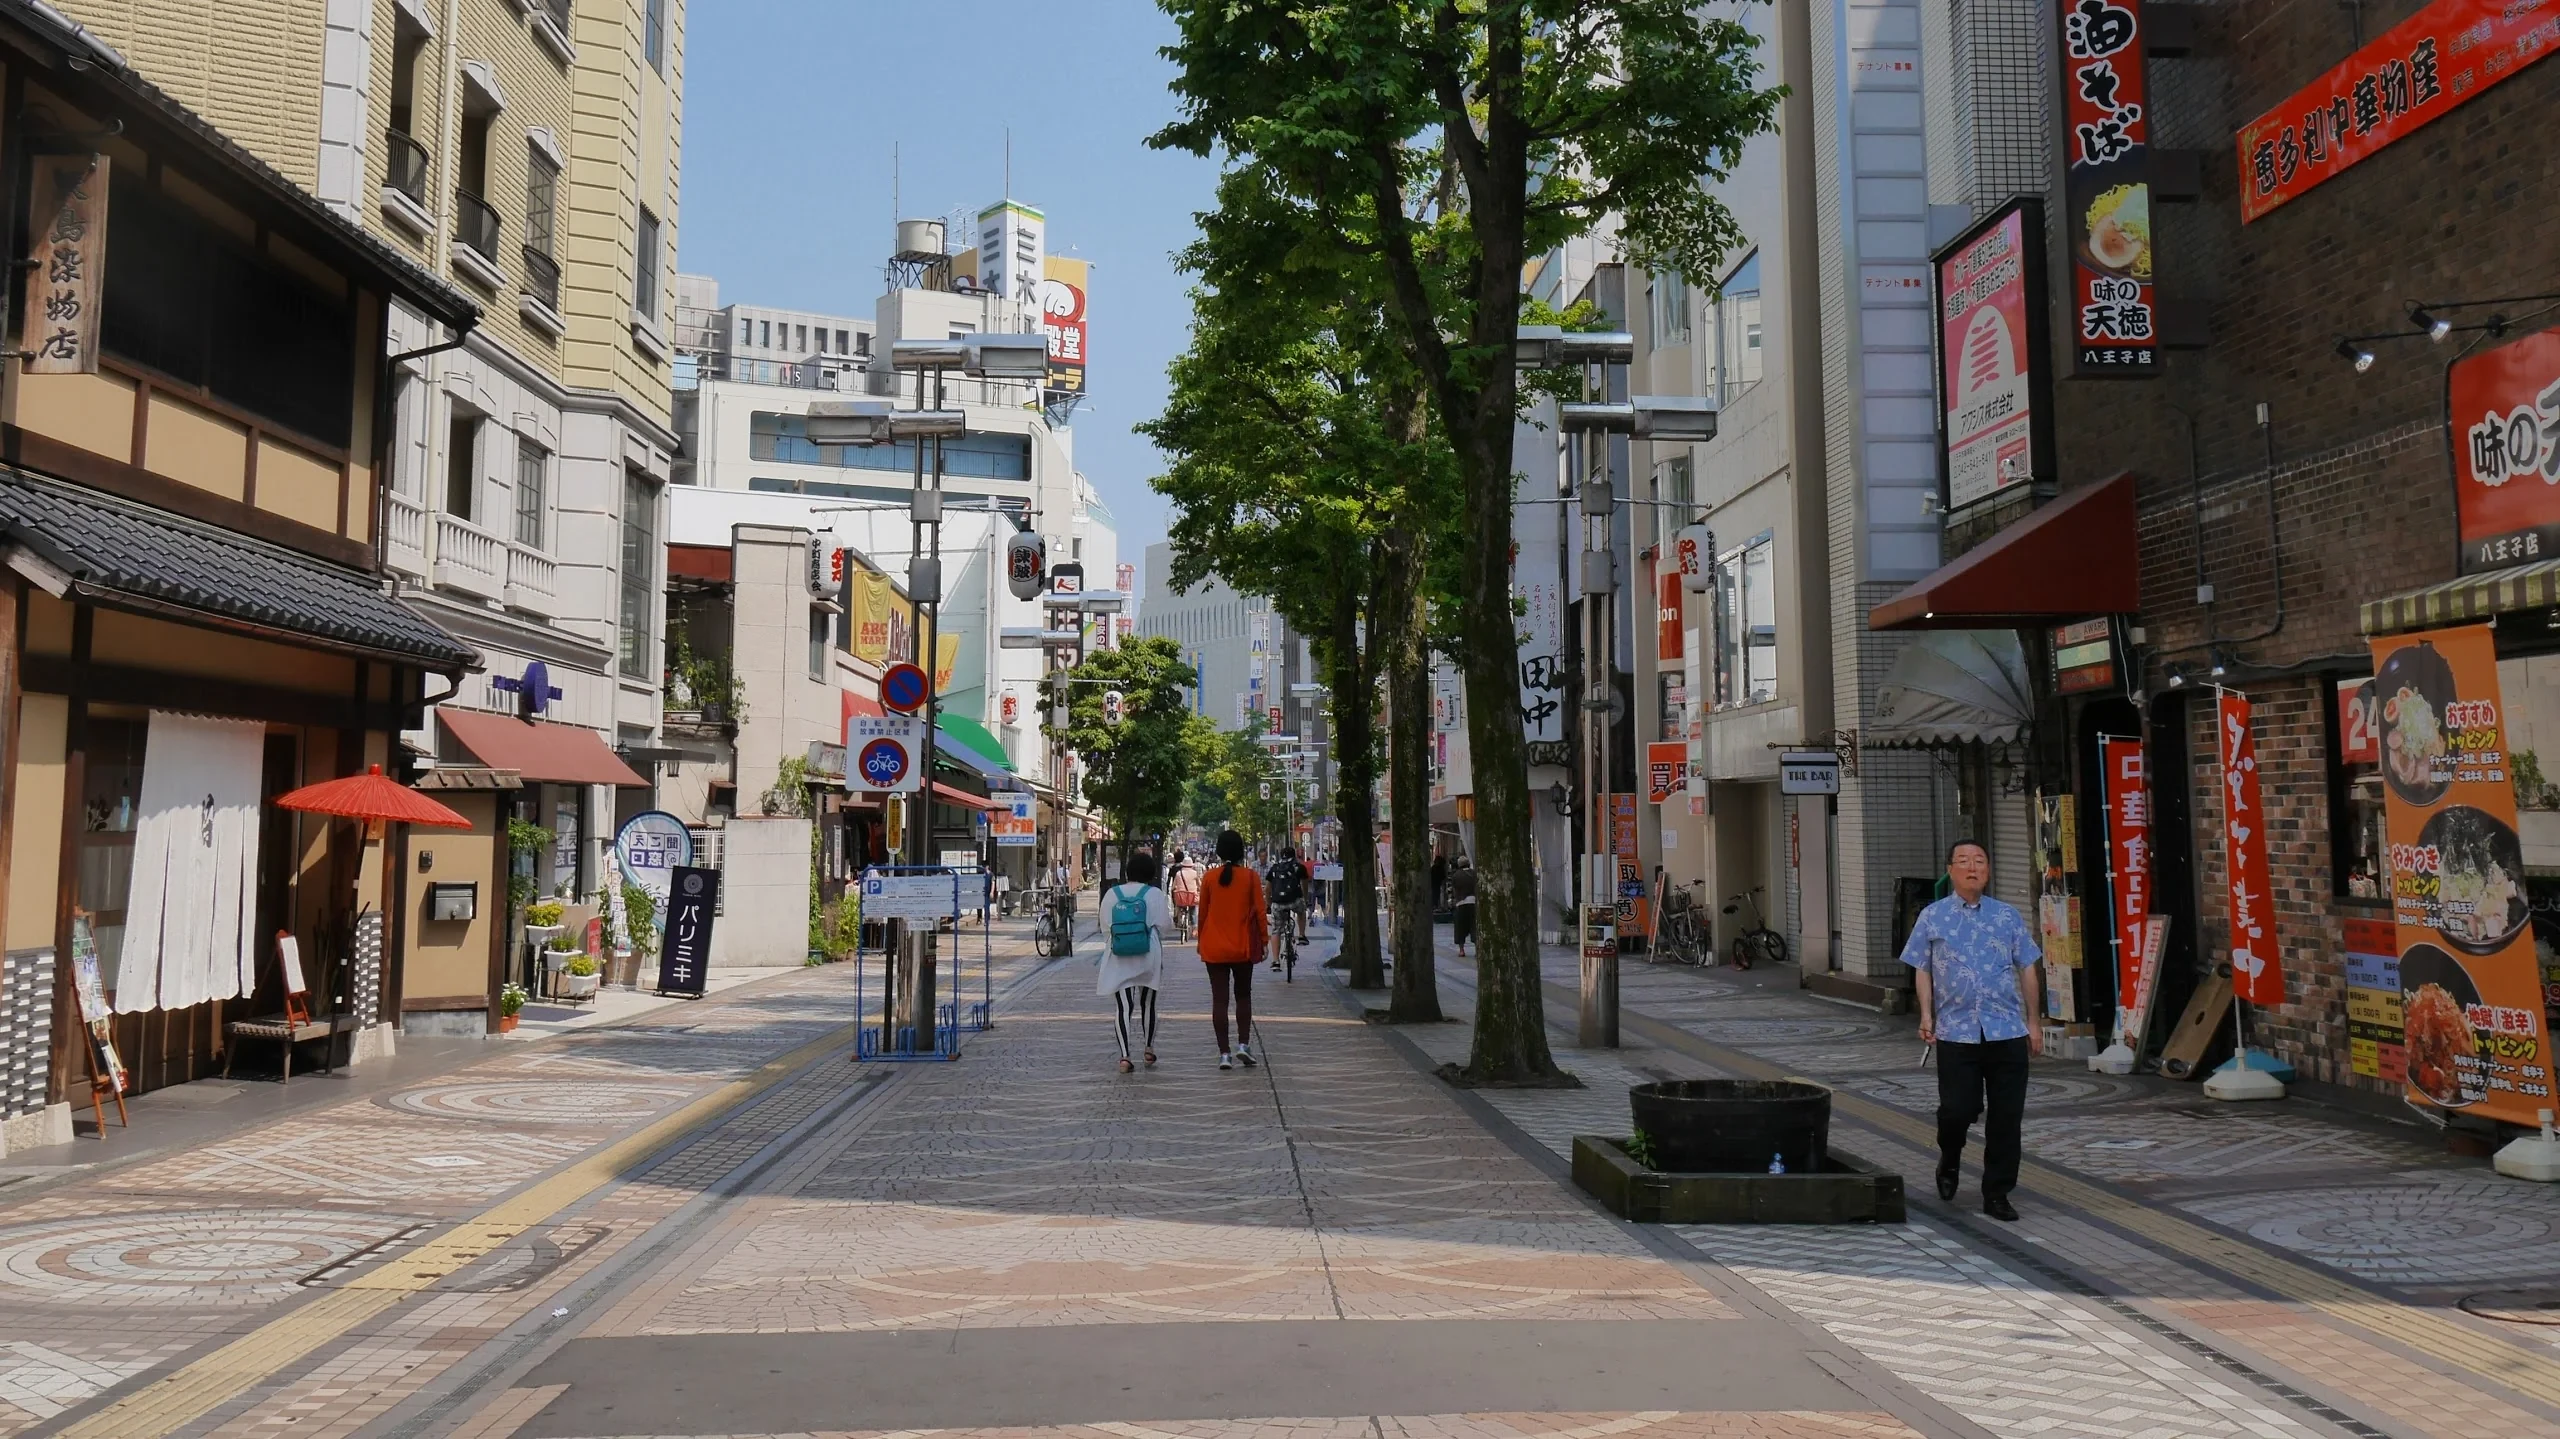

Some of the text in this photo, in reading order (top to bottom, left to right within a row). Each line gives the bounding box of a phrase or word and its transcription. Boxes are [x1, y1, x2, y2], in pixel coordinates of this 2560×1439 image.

[1857, 62, 1912, 71] テナント募集
[2067, 0, 2140, 164] 油そば
[1865, 278, 1922, 288] テナント募集
[2092, 280, 2138, 301] 味の
[2085, 305, 2150, 337] 天徳
[2084, 350, 2152, 364] 八王子店
[1960, 389, 2014, 435] アクシス株式会社
[1706, 530, 1716, 584] 中町商店会
[2481, 533, 2540, 563] 八王子店
[860, 622, 888, 635] ABC
[860, 635, 888, 645] MART
[1521, 655, 1559, 736] 田中
[1106, 694, 1118, 720] 中町
[2446, 702, 2496, 728] おすすめ
[859, 728, 910, 736] 放置禁止区域
[860, 720, 910, 728] 自転車等
[2447, 728, 2498, 750] トッピング
[867, 777, 898, 788] 八王子市
[1788, 771, 1833, 781] THE BAR
[2393, 845, 2440, 872] やみつき
[1620, 864, 1639, 881] 取
[870, 882, 880, 894] P
[2396, 875, 2440, 897] トッピング
[672, 905, 700, 983] パリミキ
[2474, 1031, 2538, 1062] トッピング
